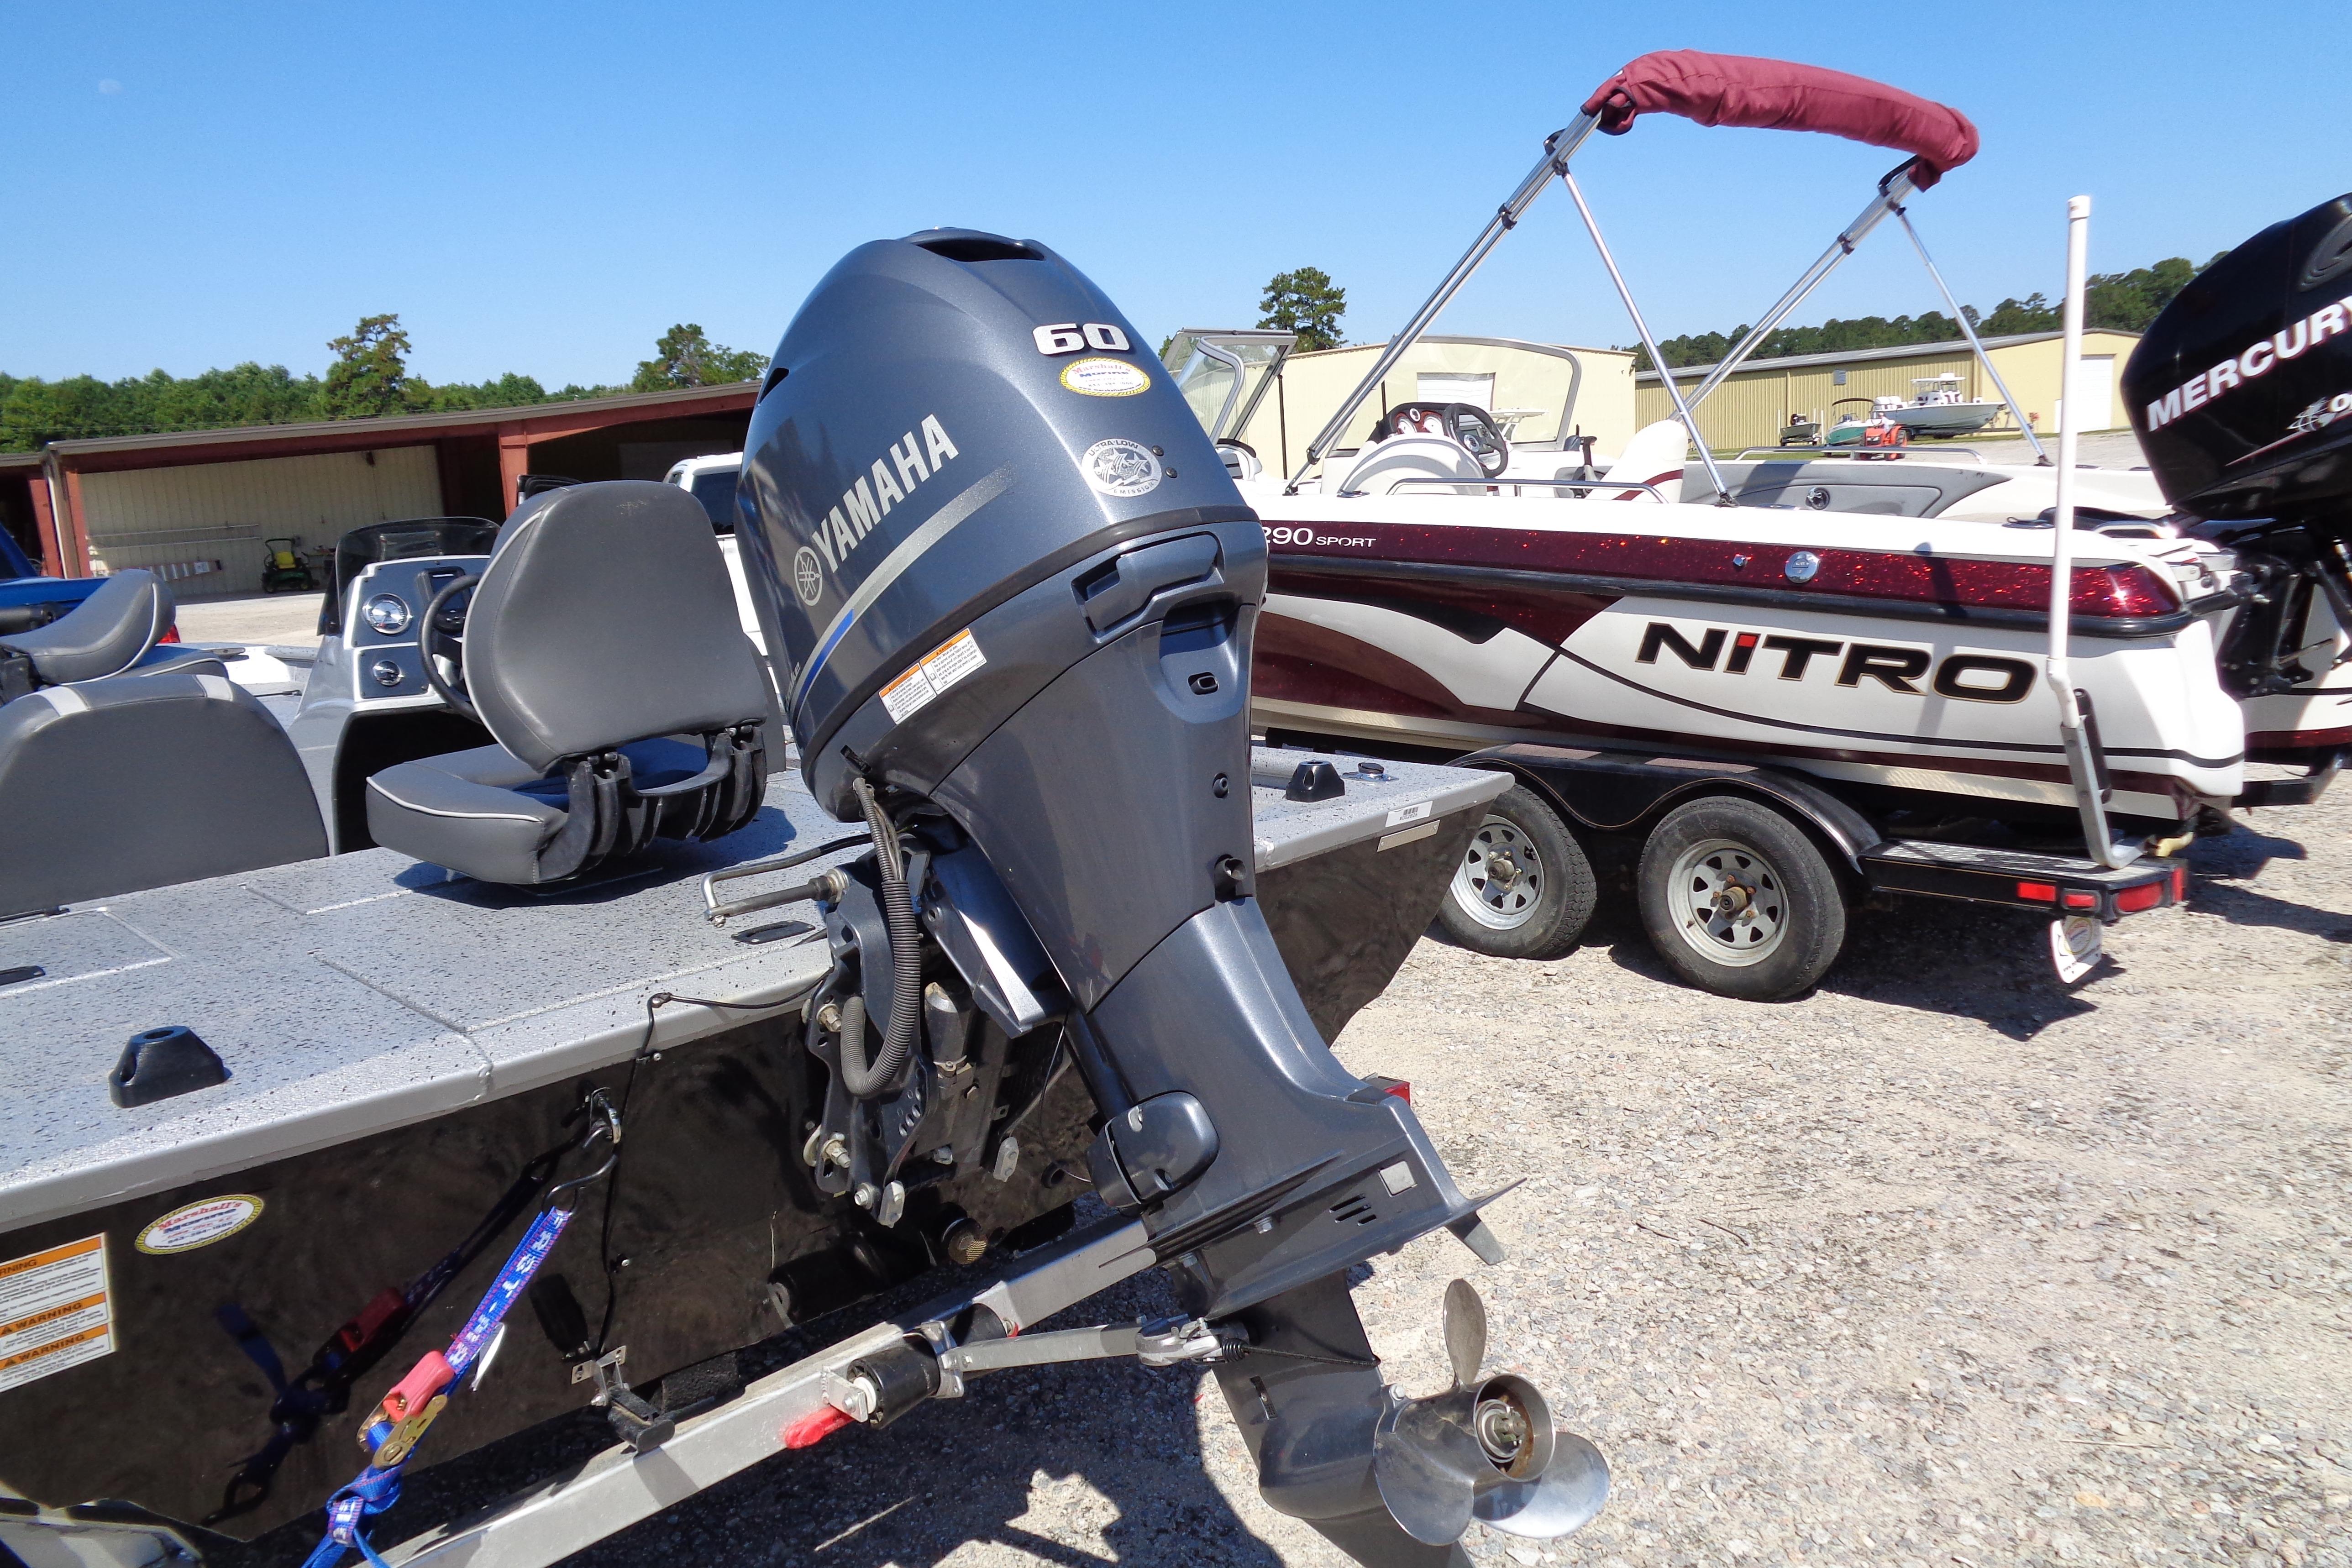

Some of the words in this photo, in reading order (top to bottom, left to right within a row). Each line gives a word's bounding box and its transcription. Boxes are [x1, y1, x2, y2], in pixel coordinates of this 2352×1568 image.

[1033, 323, 1130, 355] 60
[1072, 364, 1131, 374] Marshalls
[2330, 393, 2352, 412] O
[812, 414, 959, 573] YAMAHA
[1315, 536, 1376, 547] SPORT
[158, 1201, 242, 1230] Marshall's
[163, 1208, 236, 1234] Marine
[16, 1302, 82, 1328] WARNING
[19, 1334, 85, 1361] WARNING
